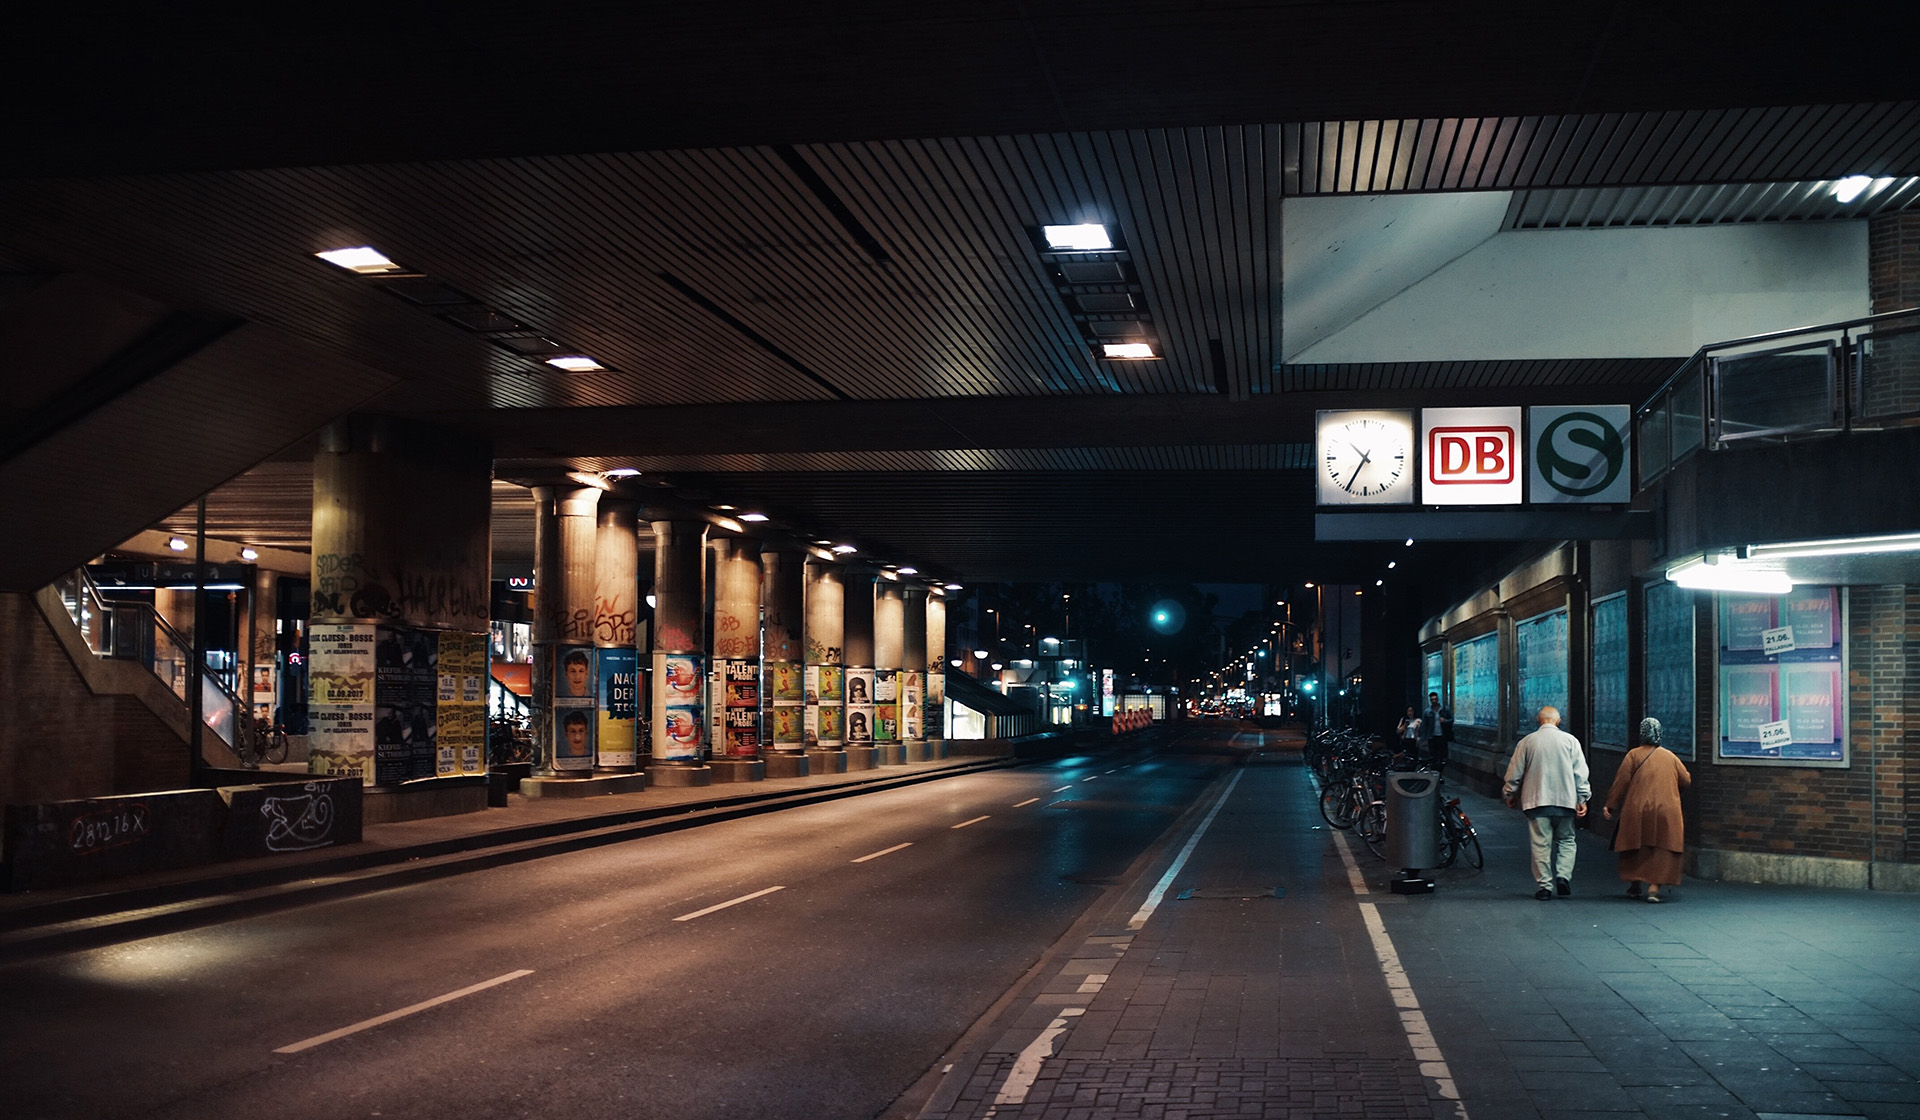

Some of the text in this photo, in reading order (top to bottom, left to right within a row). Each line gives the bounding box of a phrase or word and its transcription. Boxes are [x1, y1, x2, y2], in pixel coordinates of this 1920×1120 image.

[1440, 436, 1504, 474] DB
[322, 634, 345, 642] CLUESO
[349, 634, 373, 642] BOSSE
[1766, 634, 1790, 644] 21.06.
[1765, 643, 1794, 652] PALLADIUM
[725, 665, 758, 675] TALENT
[327, 690, 364, 698] 02.09.2017
[321, 713, 345, 721] CLUESO
[349, 712, 373, 720] BOSSE
[725, 711, 757, 721] TALENT
[1763, 728, 1787, 738] 21.06.
[1762, 737, 1790, 746] PALLADIUM
